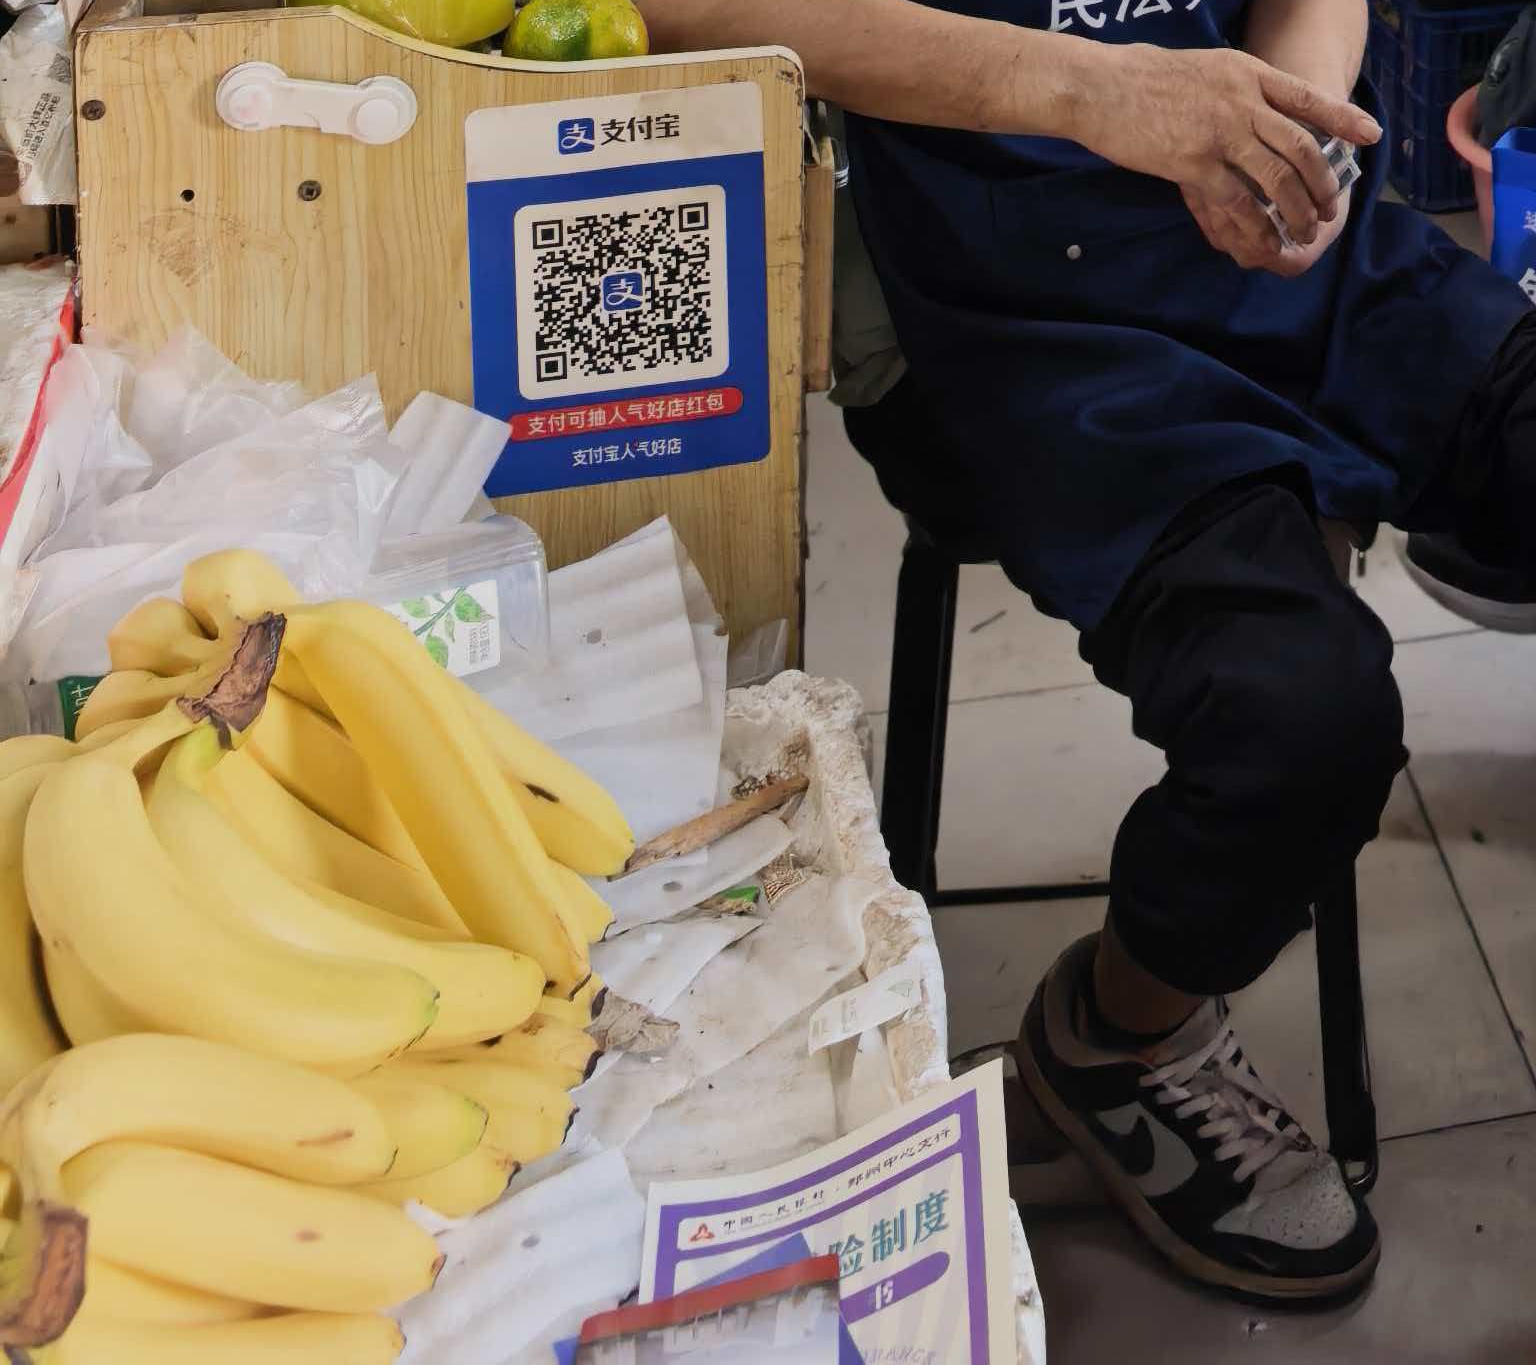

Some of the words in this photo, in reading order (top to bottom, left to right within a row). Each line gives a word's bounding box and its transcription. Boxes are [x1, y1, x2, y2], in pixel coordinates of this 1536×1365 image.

[600, 113, 680, 147] 支付宝
[528, 392, 724, 436] 支付可抽人气好店红包
[571, 437, 682, 467] 支付宝人气好店
